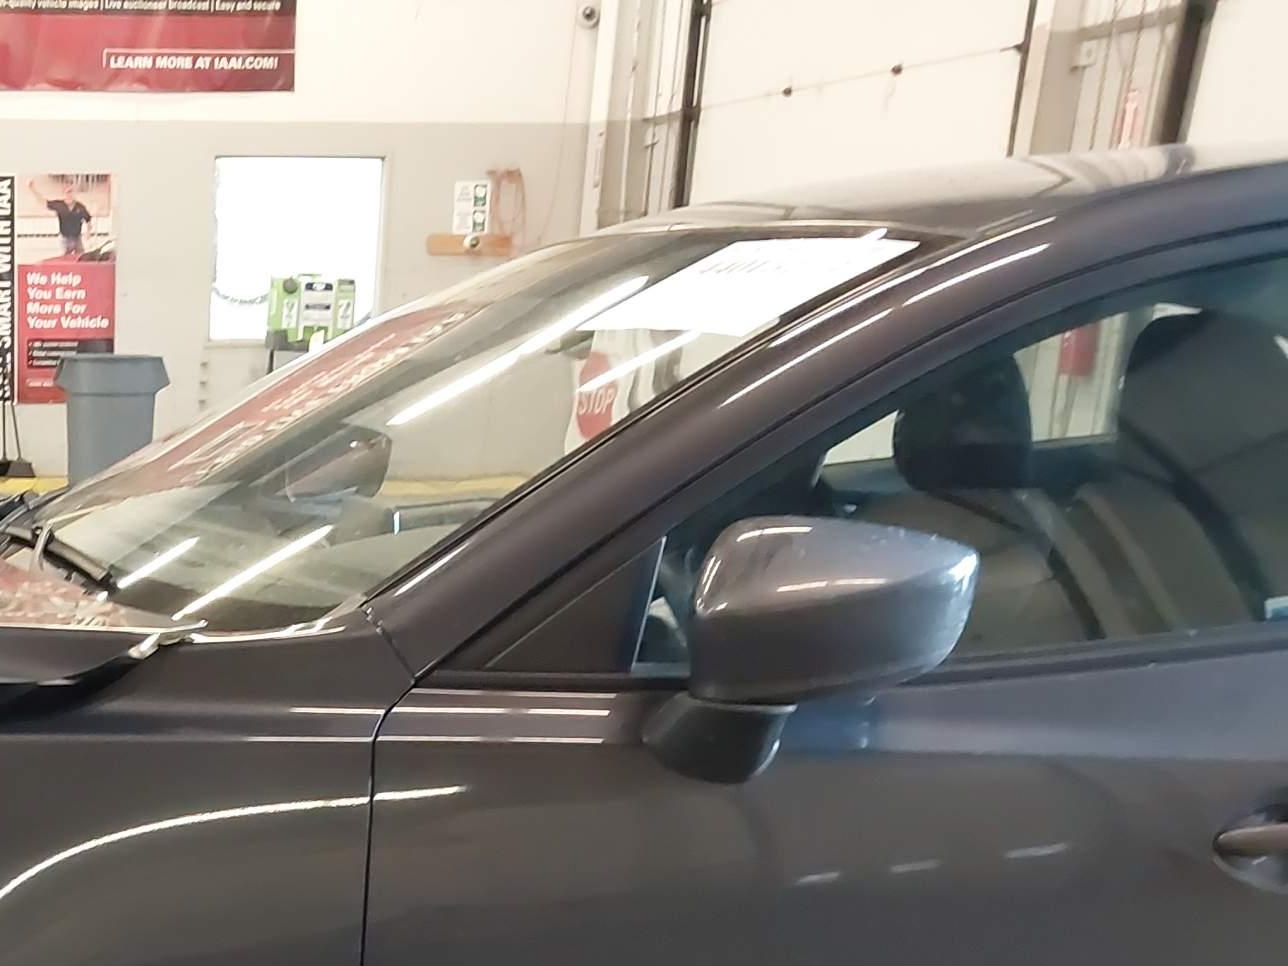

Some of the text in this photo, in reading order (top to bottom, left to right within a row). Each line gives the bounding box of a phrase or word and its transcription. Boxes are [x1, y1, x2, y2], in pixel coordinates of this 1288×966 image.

[68, 0, 98, 11] images
[168, 0, 209, 10] broadcast
[109, 55, 153, 69] LEARN
[155, 55, 193, 69] MORE
[194, 55, 213, 69] AT
[26, 271, 82, 287] We Help
[26, 287, 86, 300] You Earn
[26, 301, 87, 315] More For
[26, 315, 110, 330] Your Vehicle
[578, 387, 616, 415] STOP
